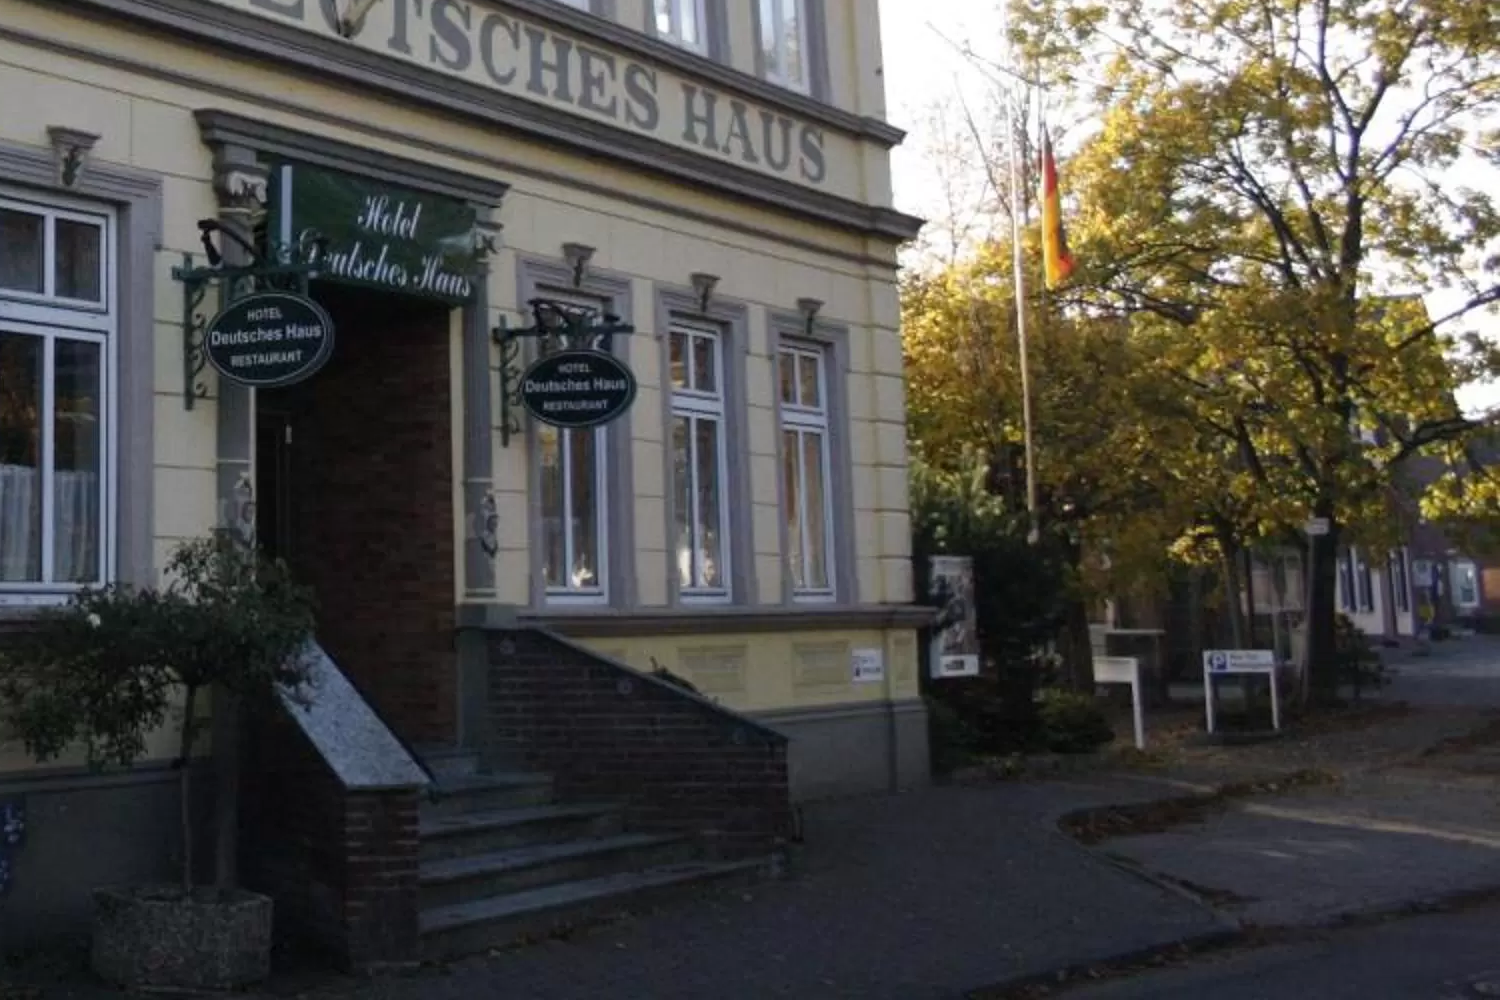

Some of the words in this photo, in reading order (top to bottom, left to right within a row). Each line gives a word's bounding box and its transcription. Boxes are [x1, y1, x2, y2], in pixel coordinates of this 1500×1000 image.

[682, 79, 826, 184] HAUS
[357, 194, 422, 240] Hotel
[412, 254, 472, 298] Haus
[246, 306, 283, 321] HOTEL
[211, 328, 283, 346] Deutsches
[285, 323, 322, 339] Haus
[229, 349, 303, 368] RESTAURANT
[557, 362, 592, 374] HOTEL
[524, 378, 590, 393] Deutsches
[593, 376, 627, 391] Haus
[542, 398, 609, 412] RESTAURANT
